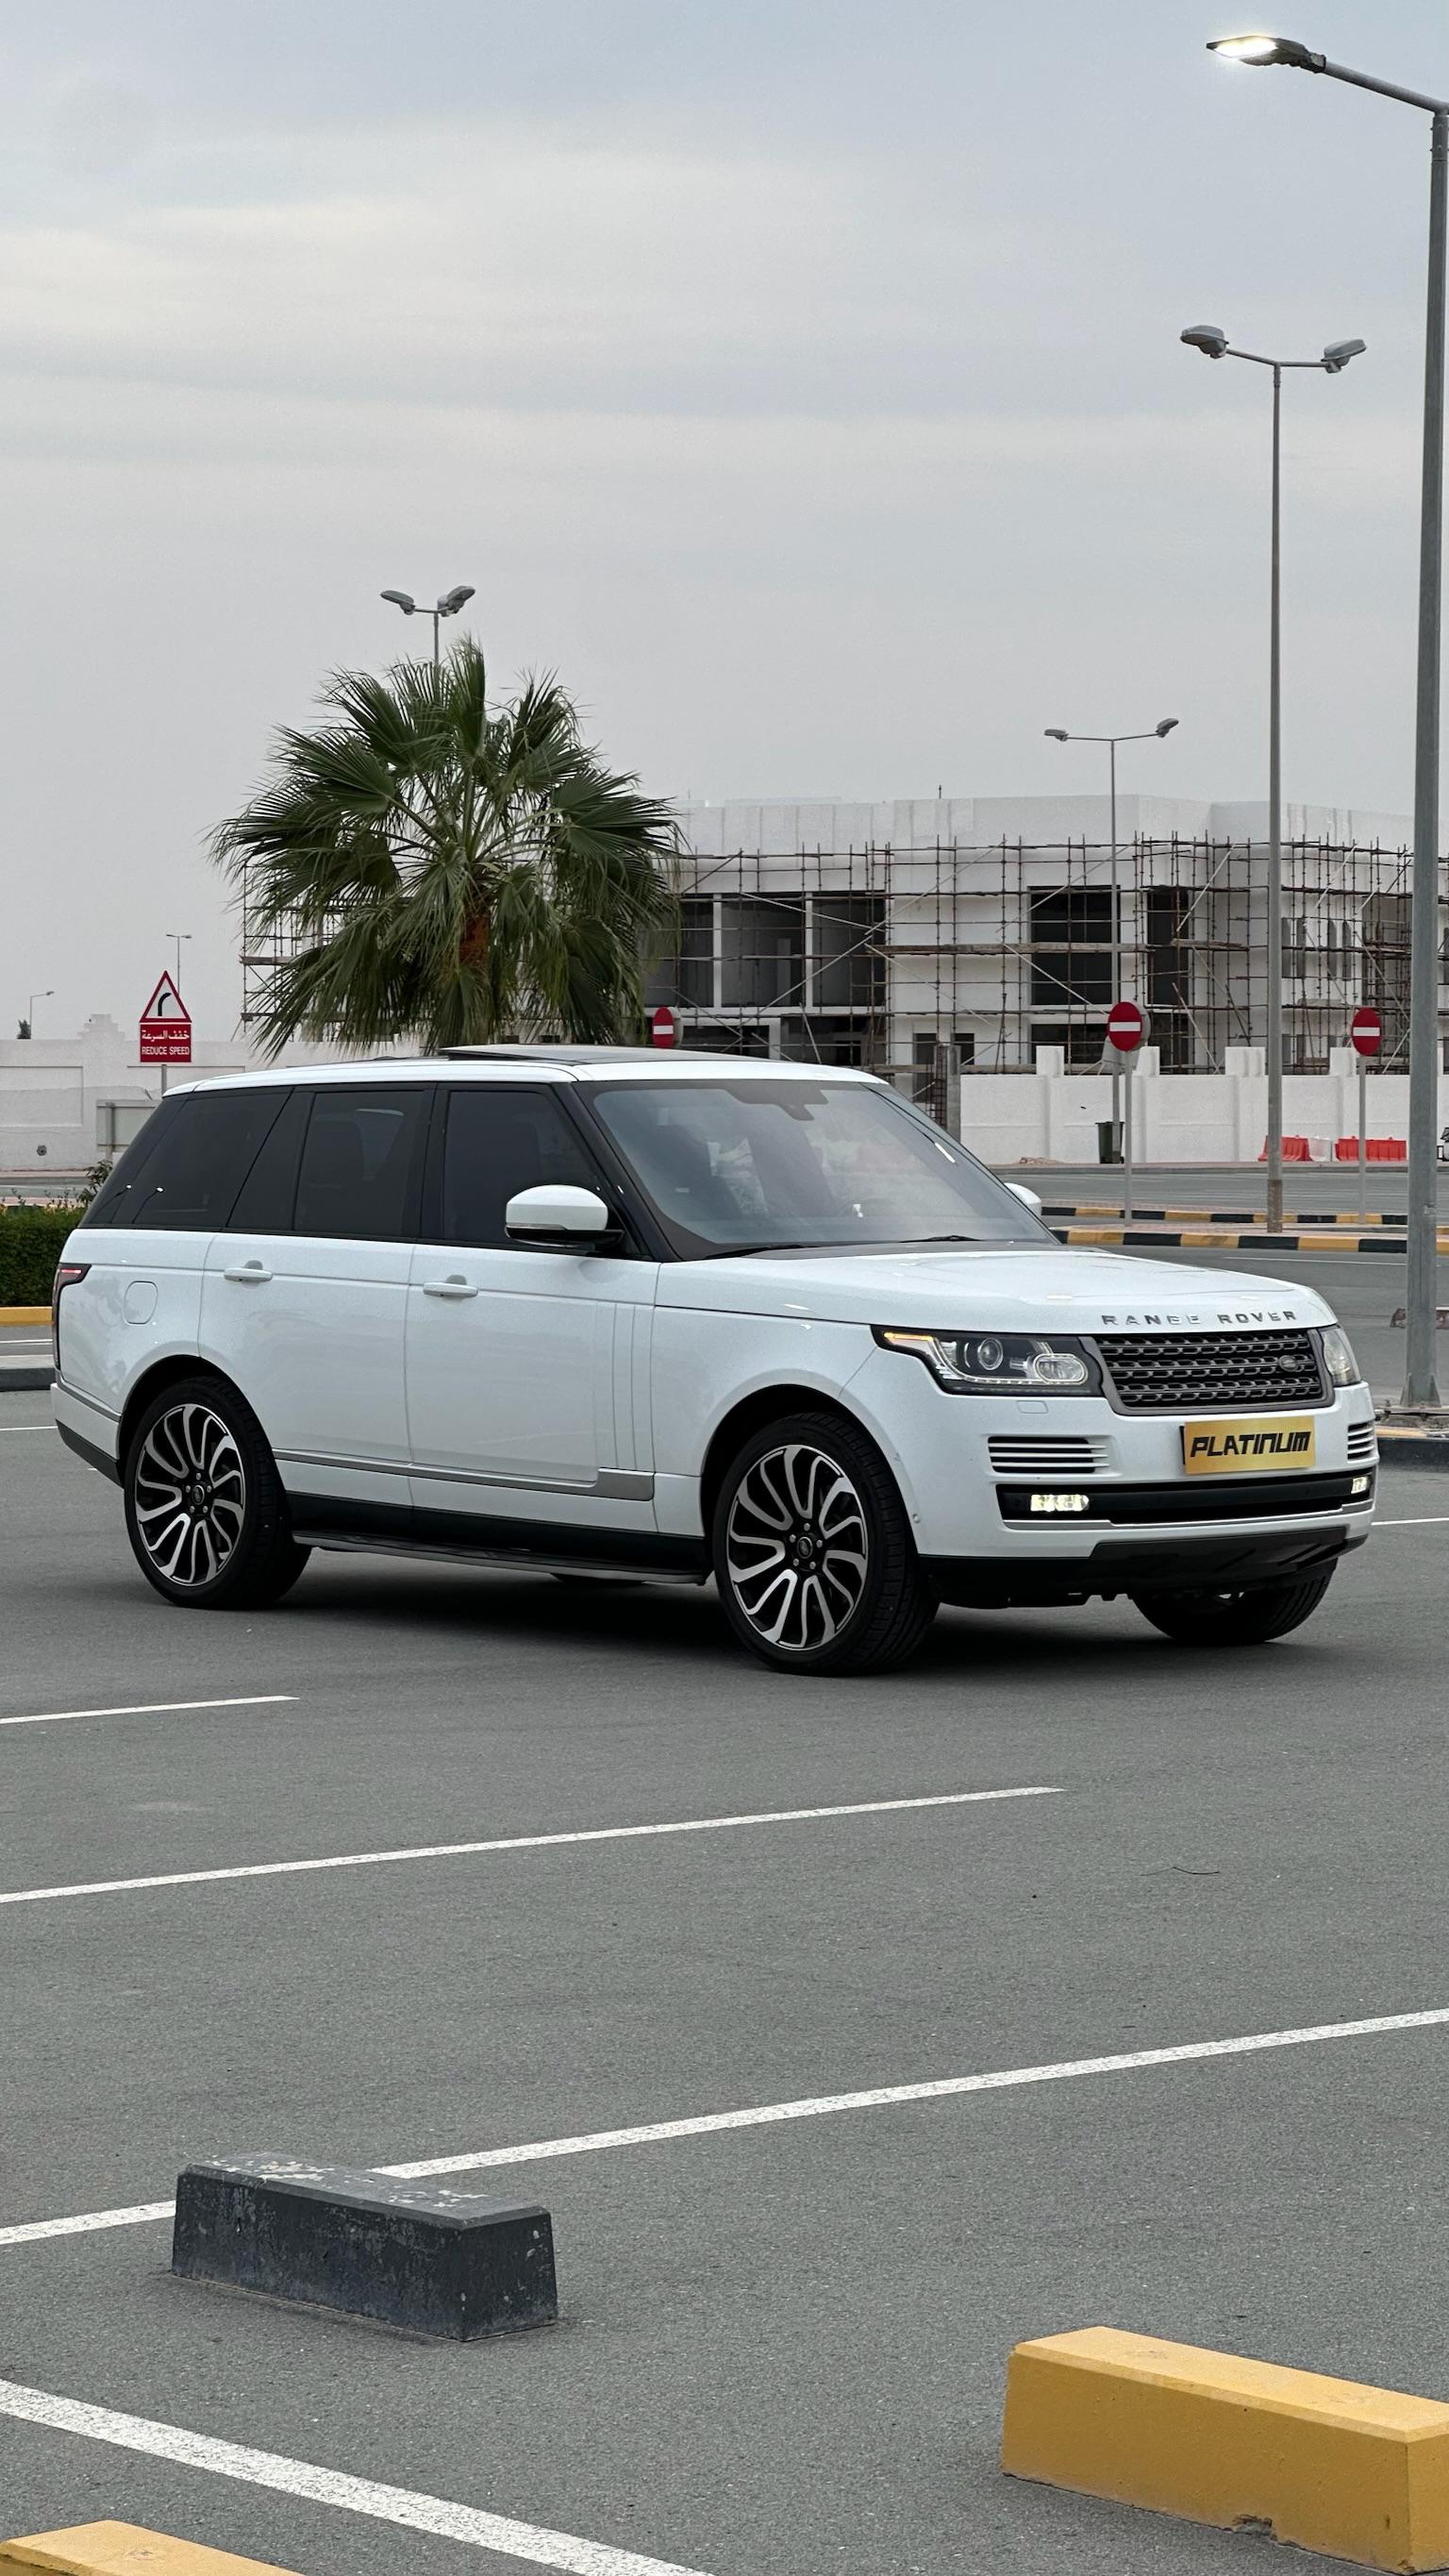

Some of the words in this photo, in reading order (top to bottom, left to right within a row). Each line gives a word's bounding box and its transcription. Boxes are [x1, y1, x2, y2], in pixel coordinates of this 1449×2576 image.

[142, 1029, 168, 1042] السرعة
[168, 1030, 190, 1040] خفف
[142, 1046, 168, 1055] REDUCE
[169, 1046, 190, 1055] SPEED
[1101, 1314, 1201, 1326] RANGE
[1217, 1310, 1297, 1324] ROVER
[1190, 1431, 1311, 1458] PLATINUM
